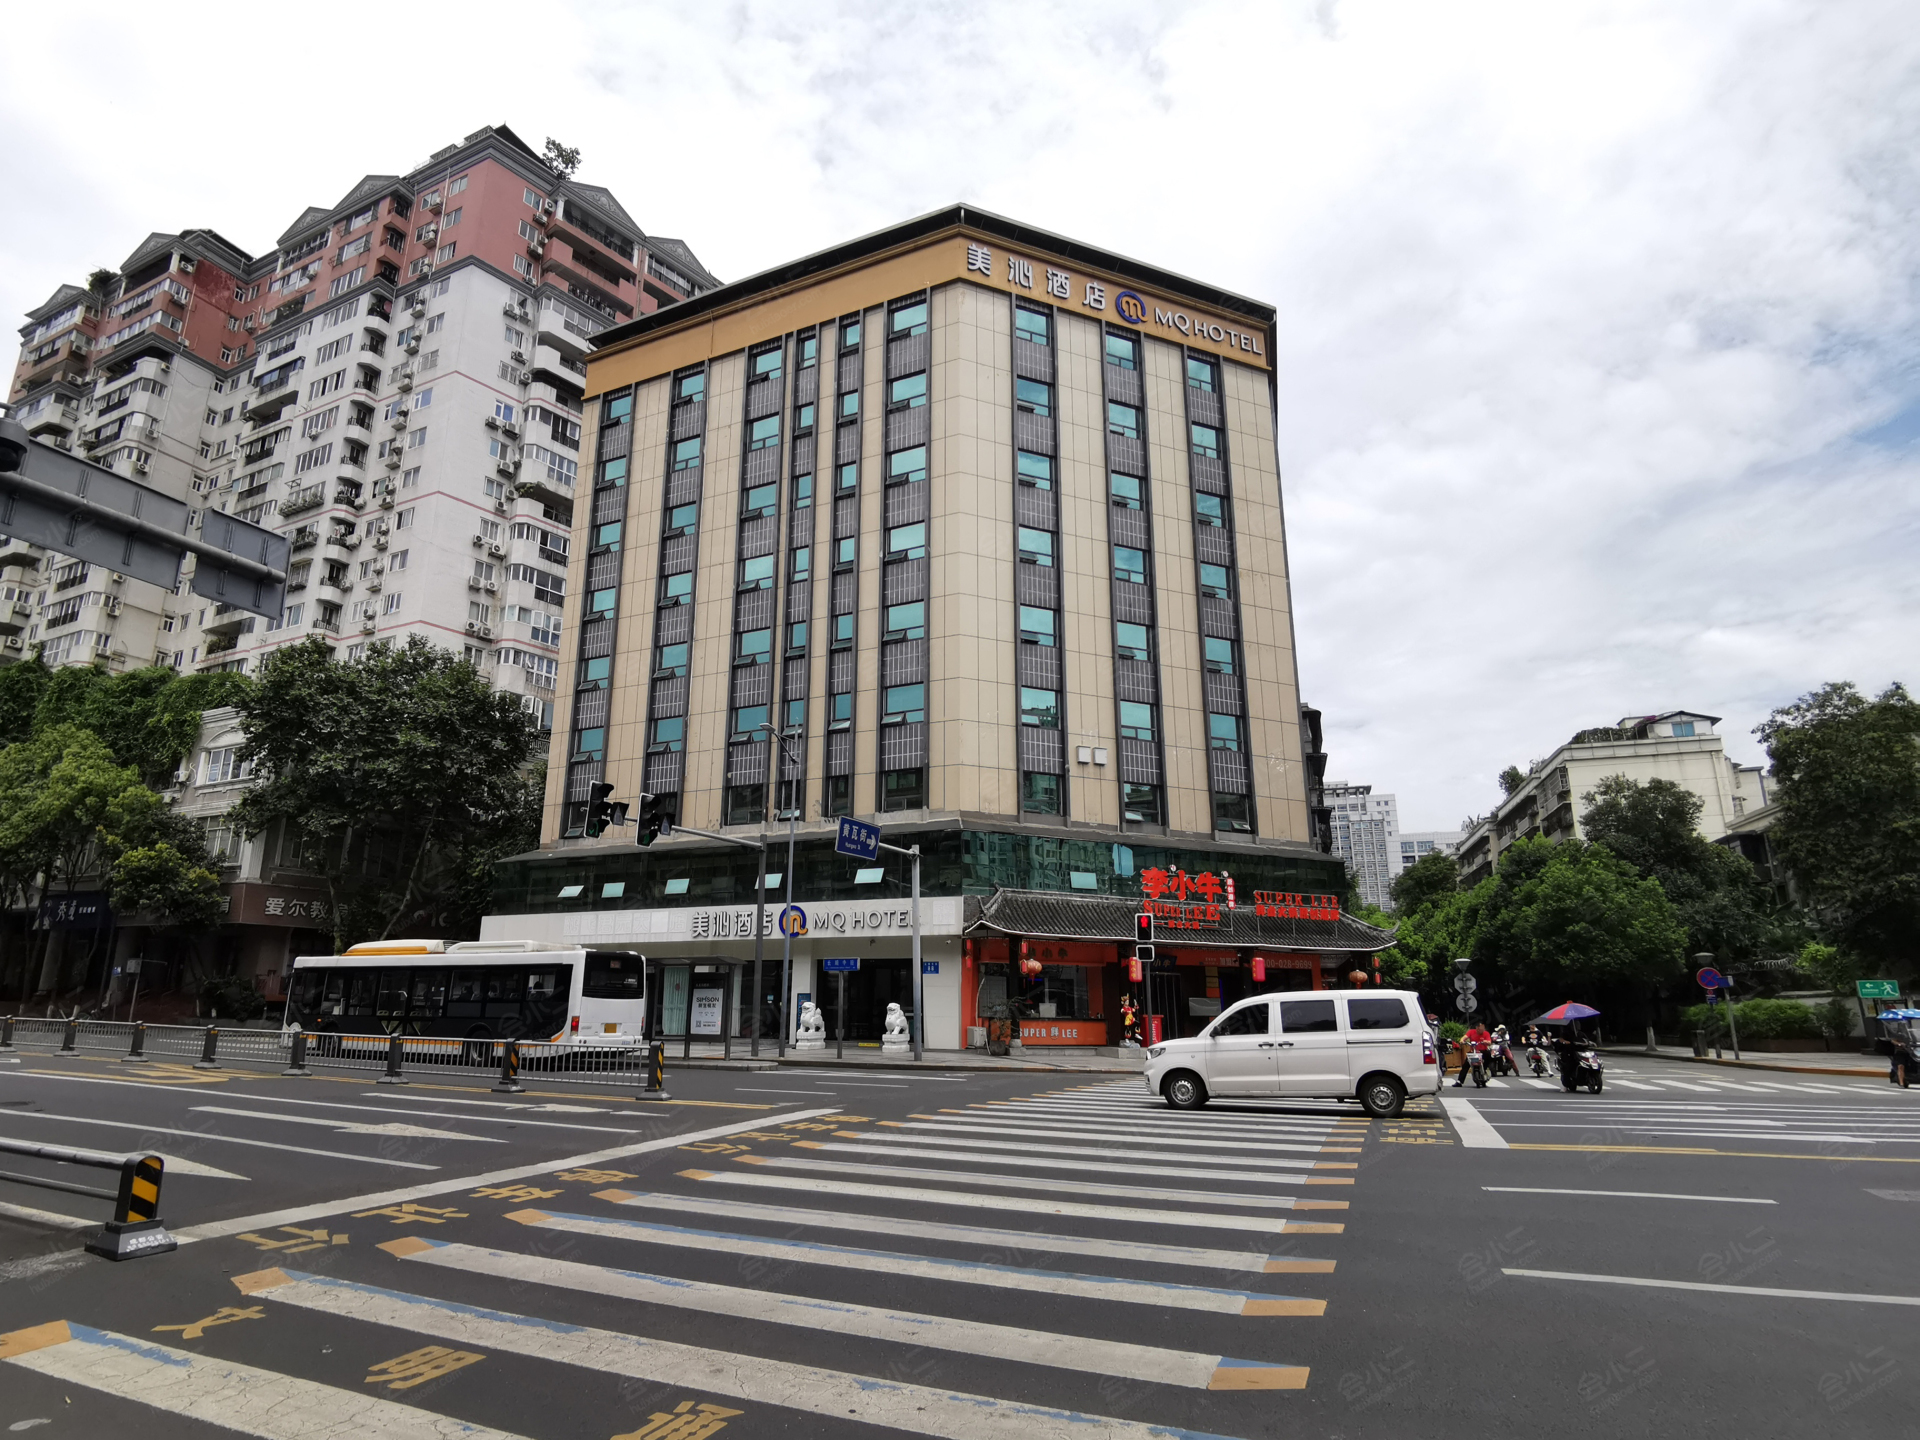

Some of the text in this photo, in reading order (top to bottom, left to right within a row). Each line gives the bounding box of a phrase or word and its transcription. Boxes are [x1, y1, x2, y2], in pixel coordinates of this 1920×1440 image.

[967, 243, 1106, 310] 美沁酒店
[1155, 307, 1263, 355] MQ HOTEL
[842, 823, 868, 842] 黄瓦街
[1142, 867, 1222, 902] 李小牛
[1254, 891, 1339, 908] SUPER LEE
[1143, 900, 1220, 920] SUPER LEE
[691, 910, 774, 938] 美沁酒店
[813, 912, 845, 932] MQ
[1019, 1027, 1047, 1037] SUPER
[1062, 1028, 1078, 1038] LEE
